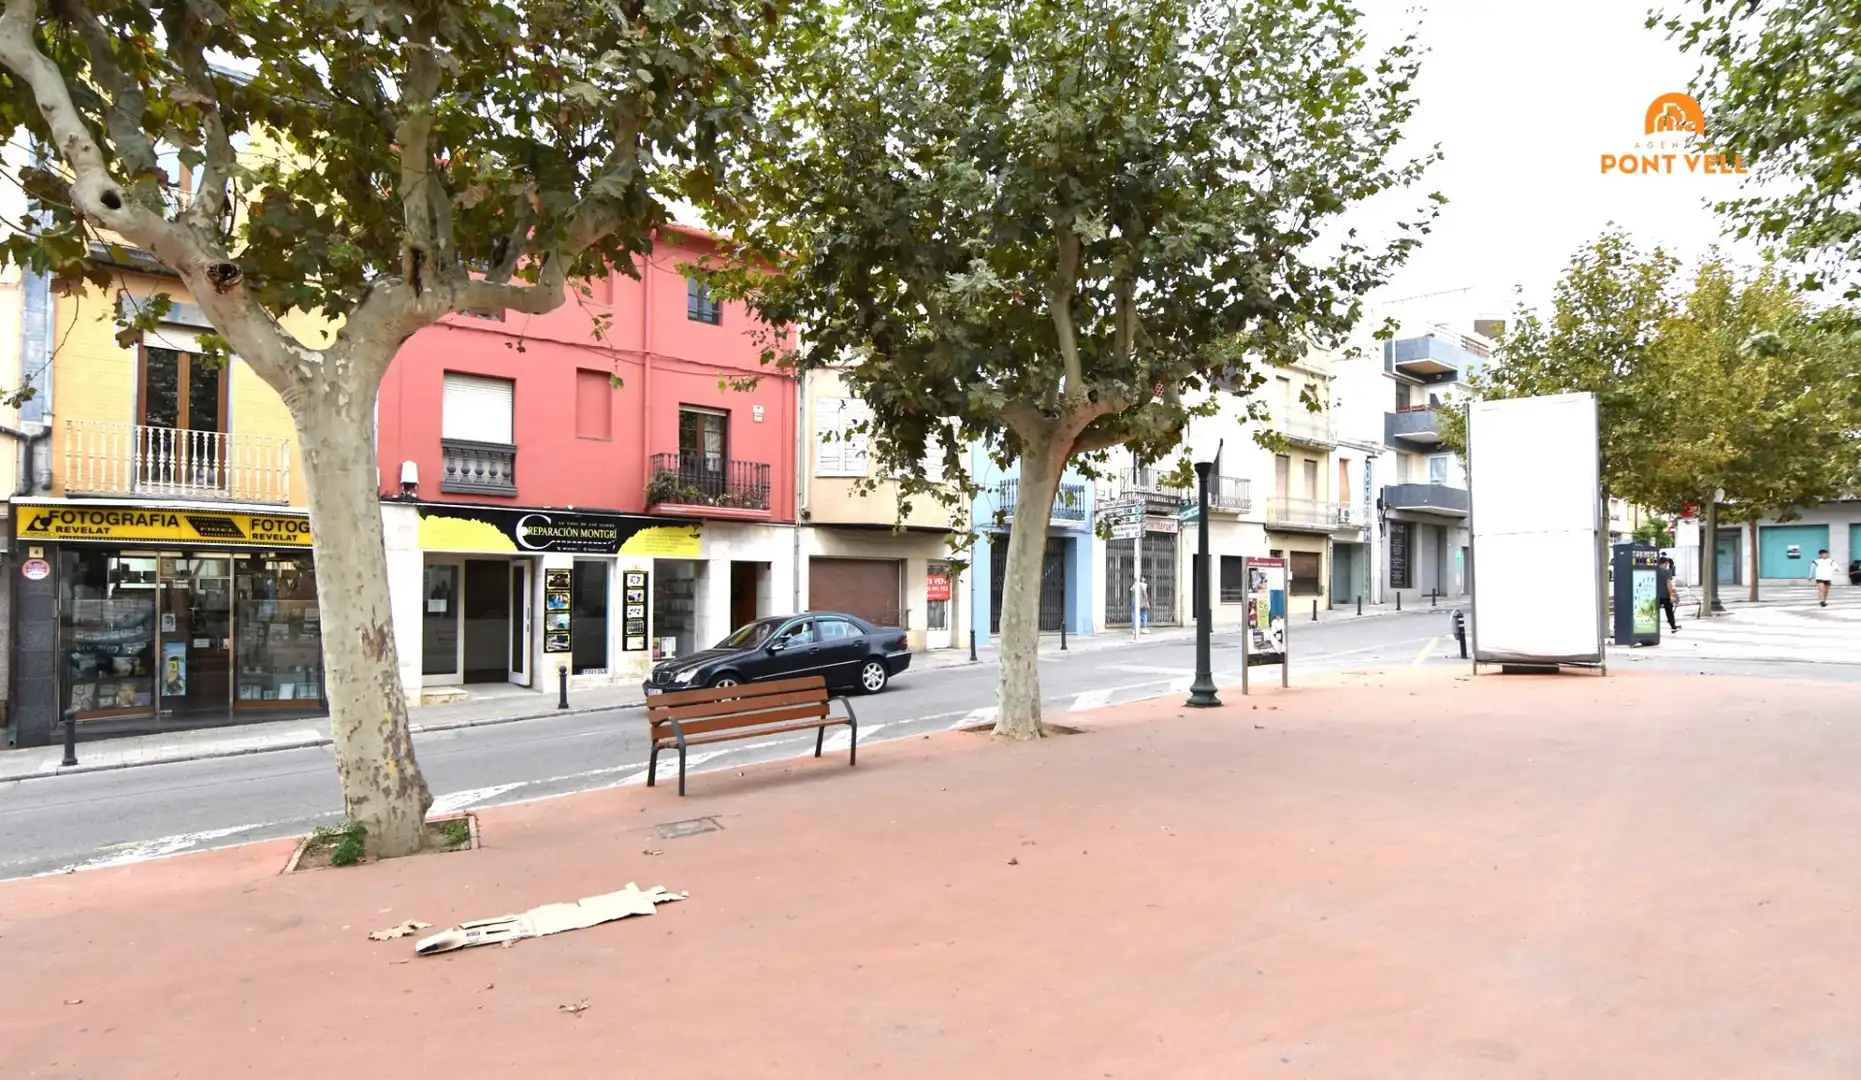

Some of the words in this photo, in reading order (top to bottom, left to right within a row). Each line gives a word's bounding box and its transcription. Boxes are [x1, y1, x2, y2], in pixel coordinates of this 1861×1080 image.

[49, 510, 179, 528] FOTOGRAFIA
[55, 525, 111, 534] REVELAT
[527, 526, 578, 537] REPARACIÓN
[580, 528, 617, 539] MONTGRÍ
[252, 533, 298, 541] REVELAT
